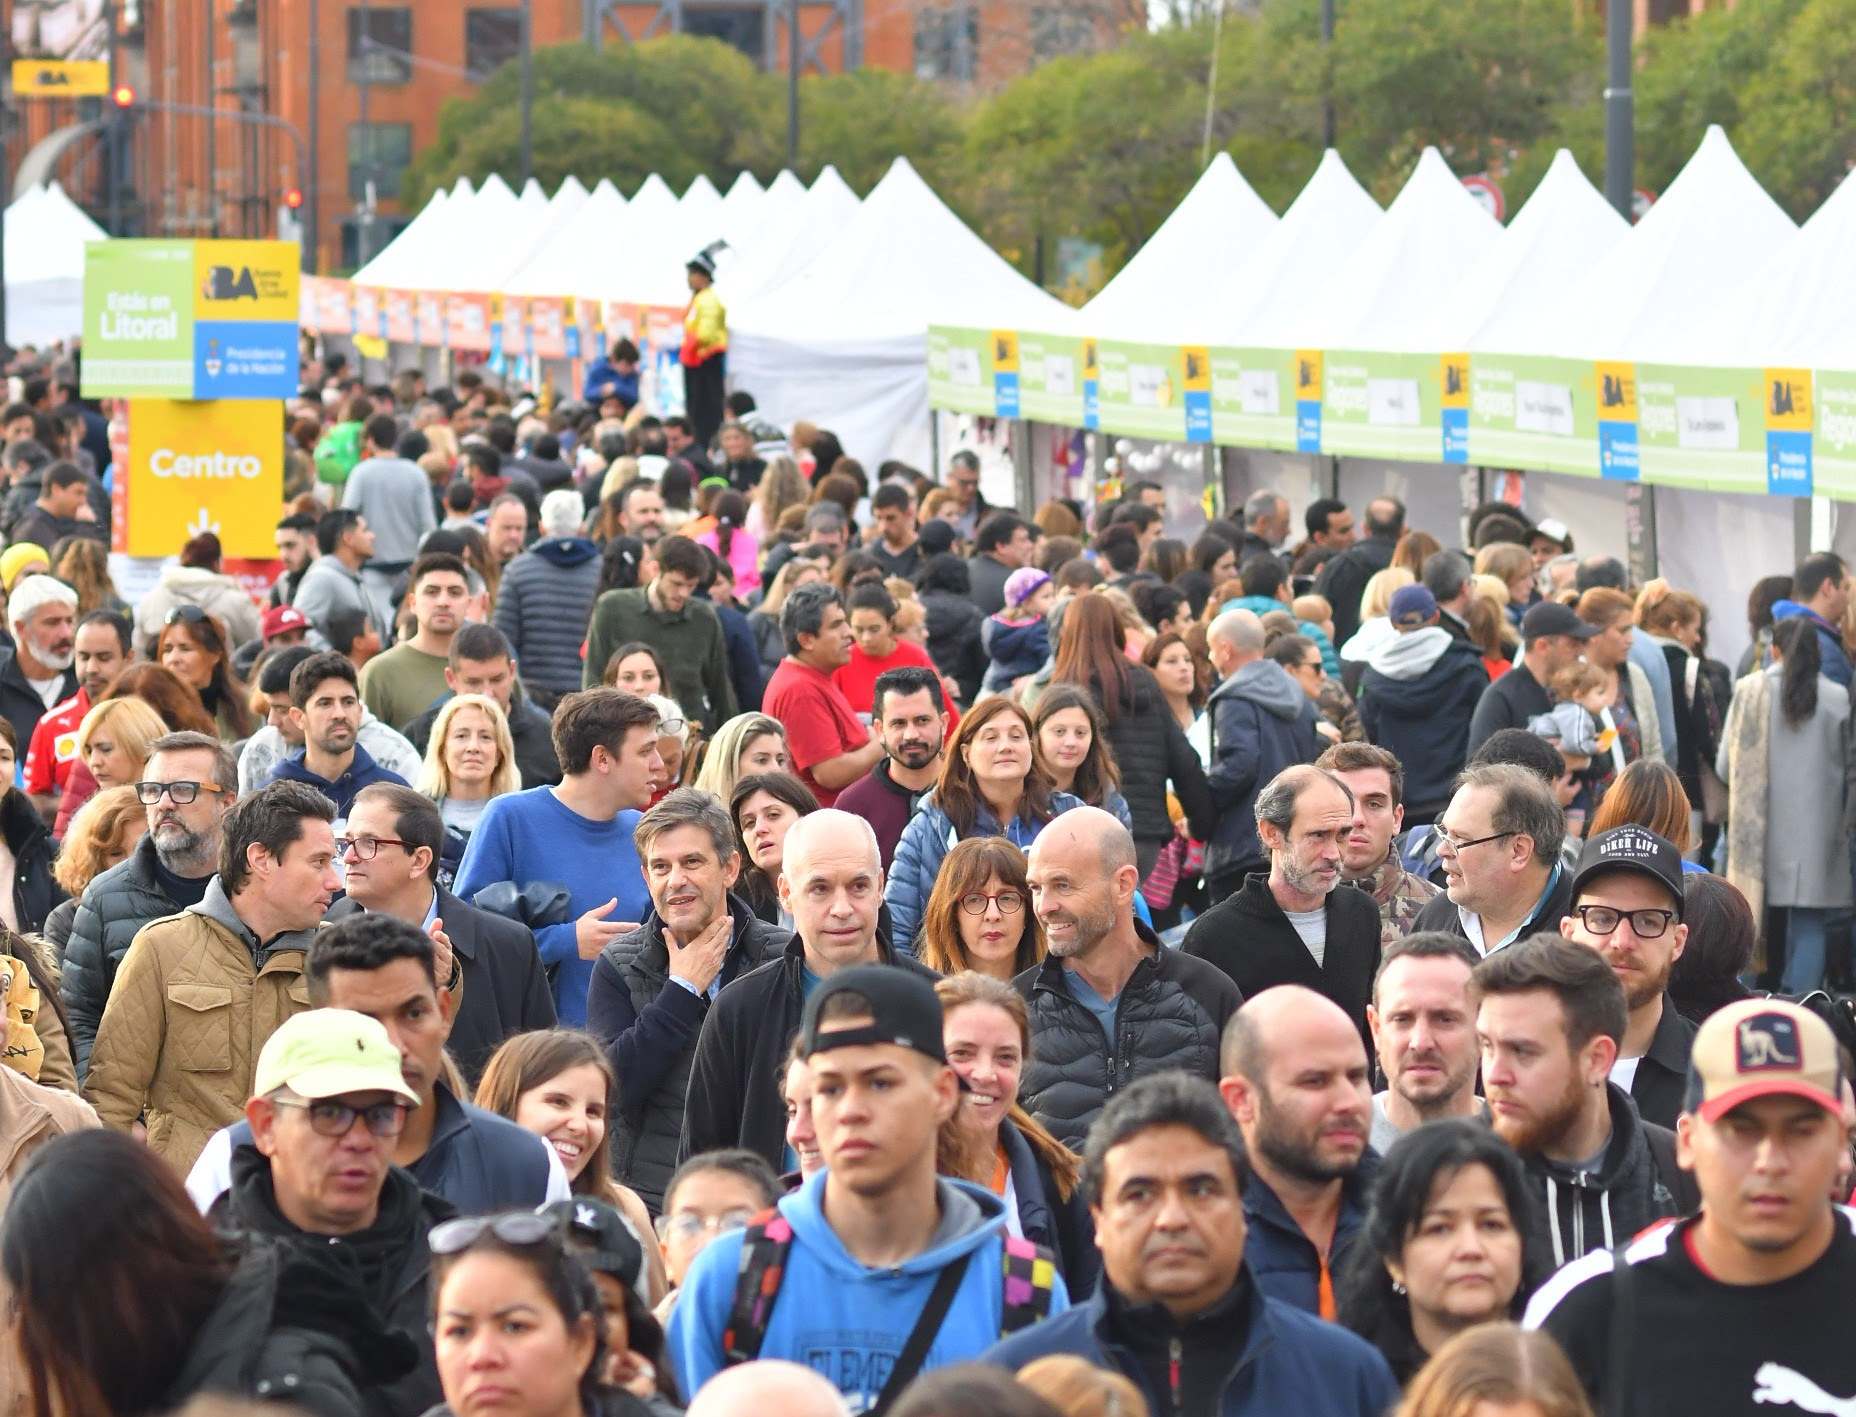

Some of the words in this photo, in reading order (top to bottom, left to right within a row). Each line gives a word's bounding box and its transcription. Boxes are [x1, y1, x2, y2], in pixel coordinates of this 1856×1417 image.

[204, 266, 259, 301] BA
[107, 291, 148, 311] Estás
[151, 296, 171, 311] en
[101, 310, 178, 340] Litoral
[226, 347, 287, 361] Presidencia
[150, 448, 262, 479] Centro
[1636, 838, 1659, 855] LIFE
